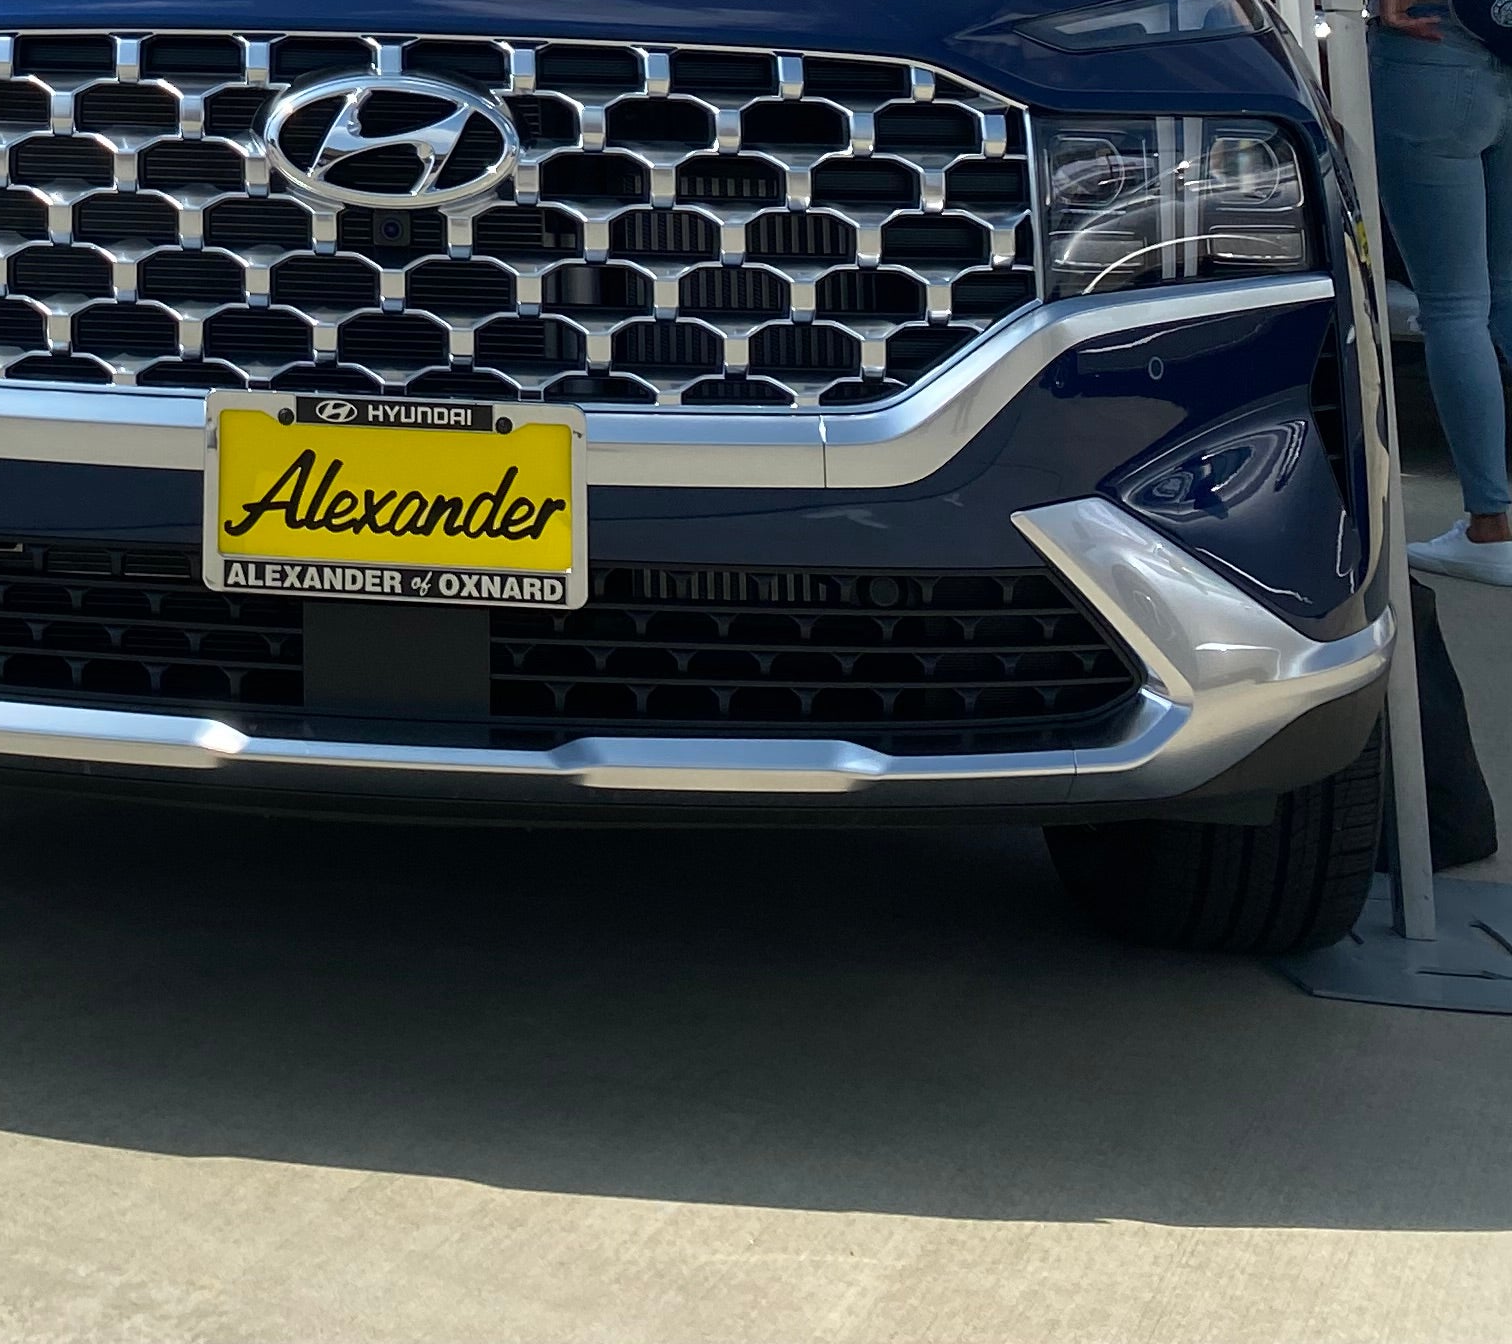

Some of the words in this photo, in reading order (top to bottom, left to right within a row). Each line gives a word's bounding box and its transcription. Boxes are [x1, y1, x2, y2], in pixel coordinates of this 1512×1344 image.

[367, 405, 473, 427] HYUNDAI
[223, 448, 567, 541] Alexander
[226, 562, 403, 595] ALEXANDER
[410, 571, 432, 597] of
[439, 573, 565, 602] OXNARD
